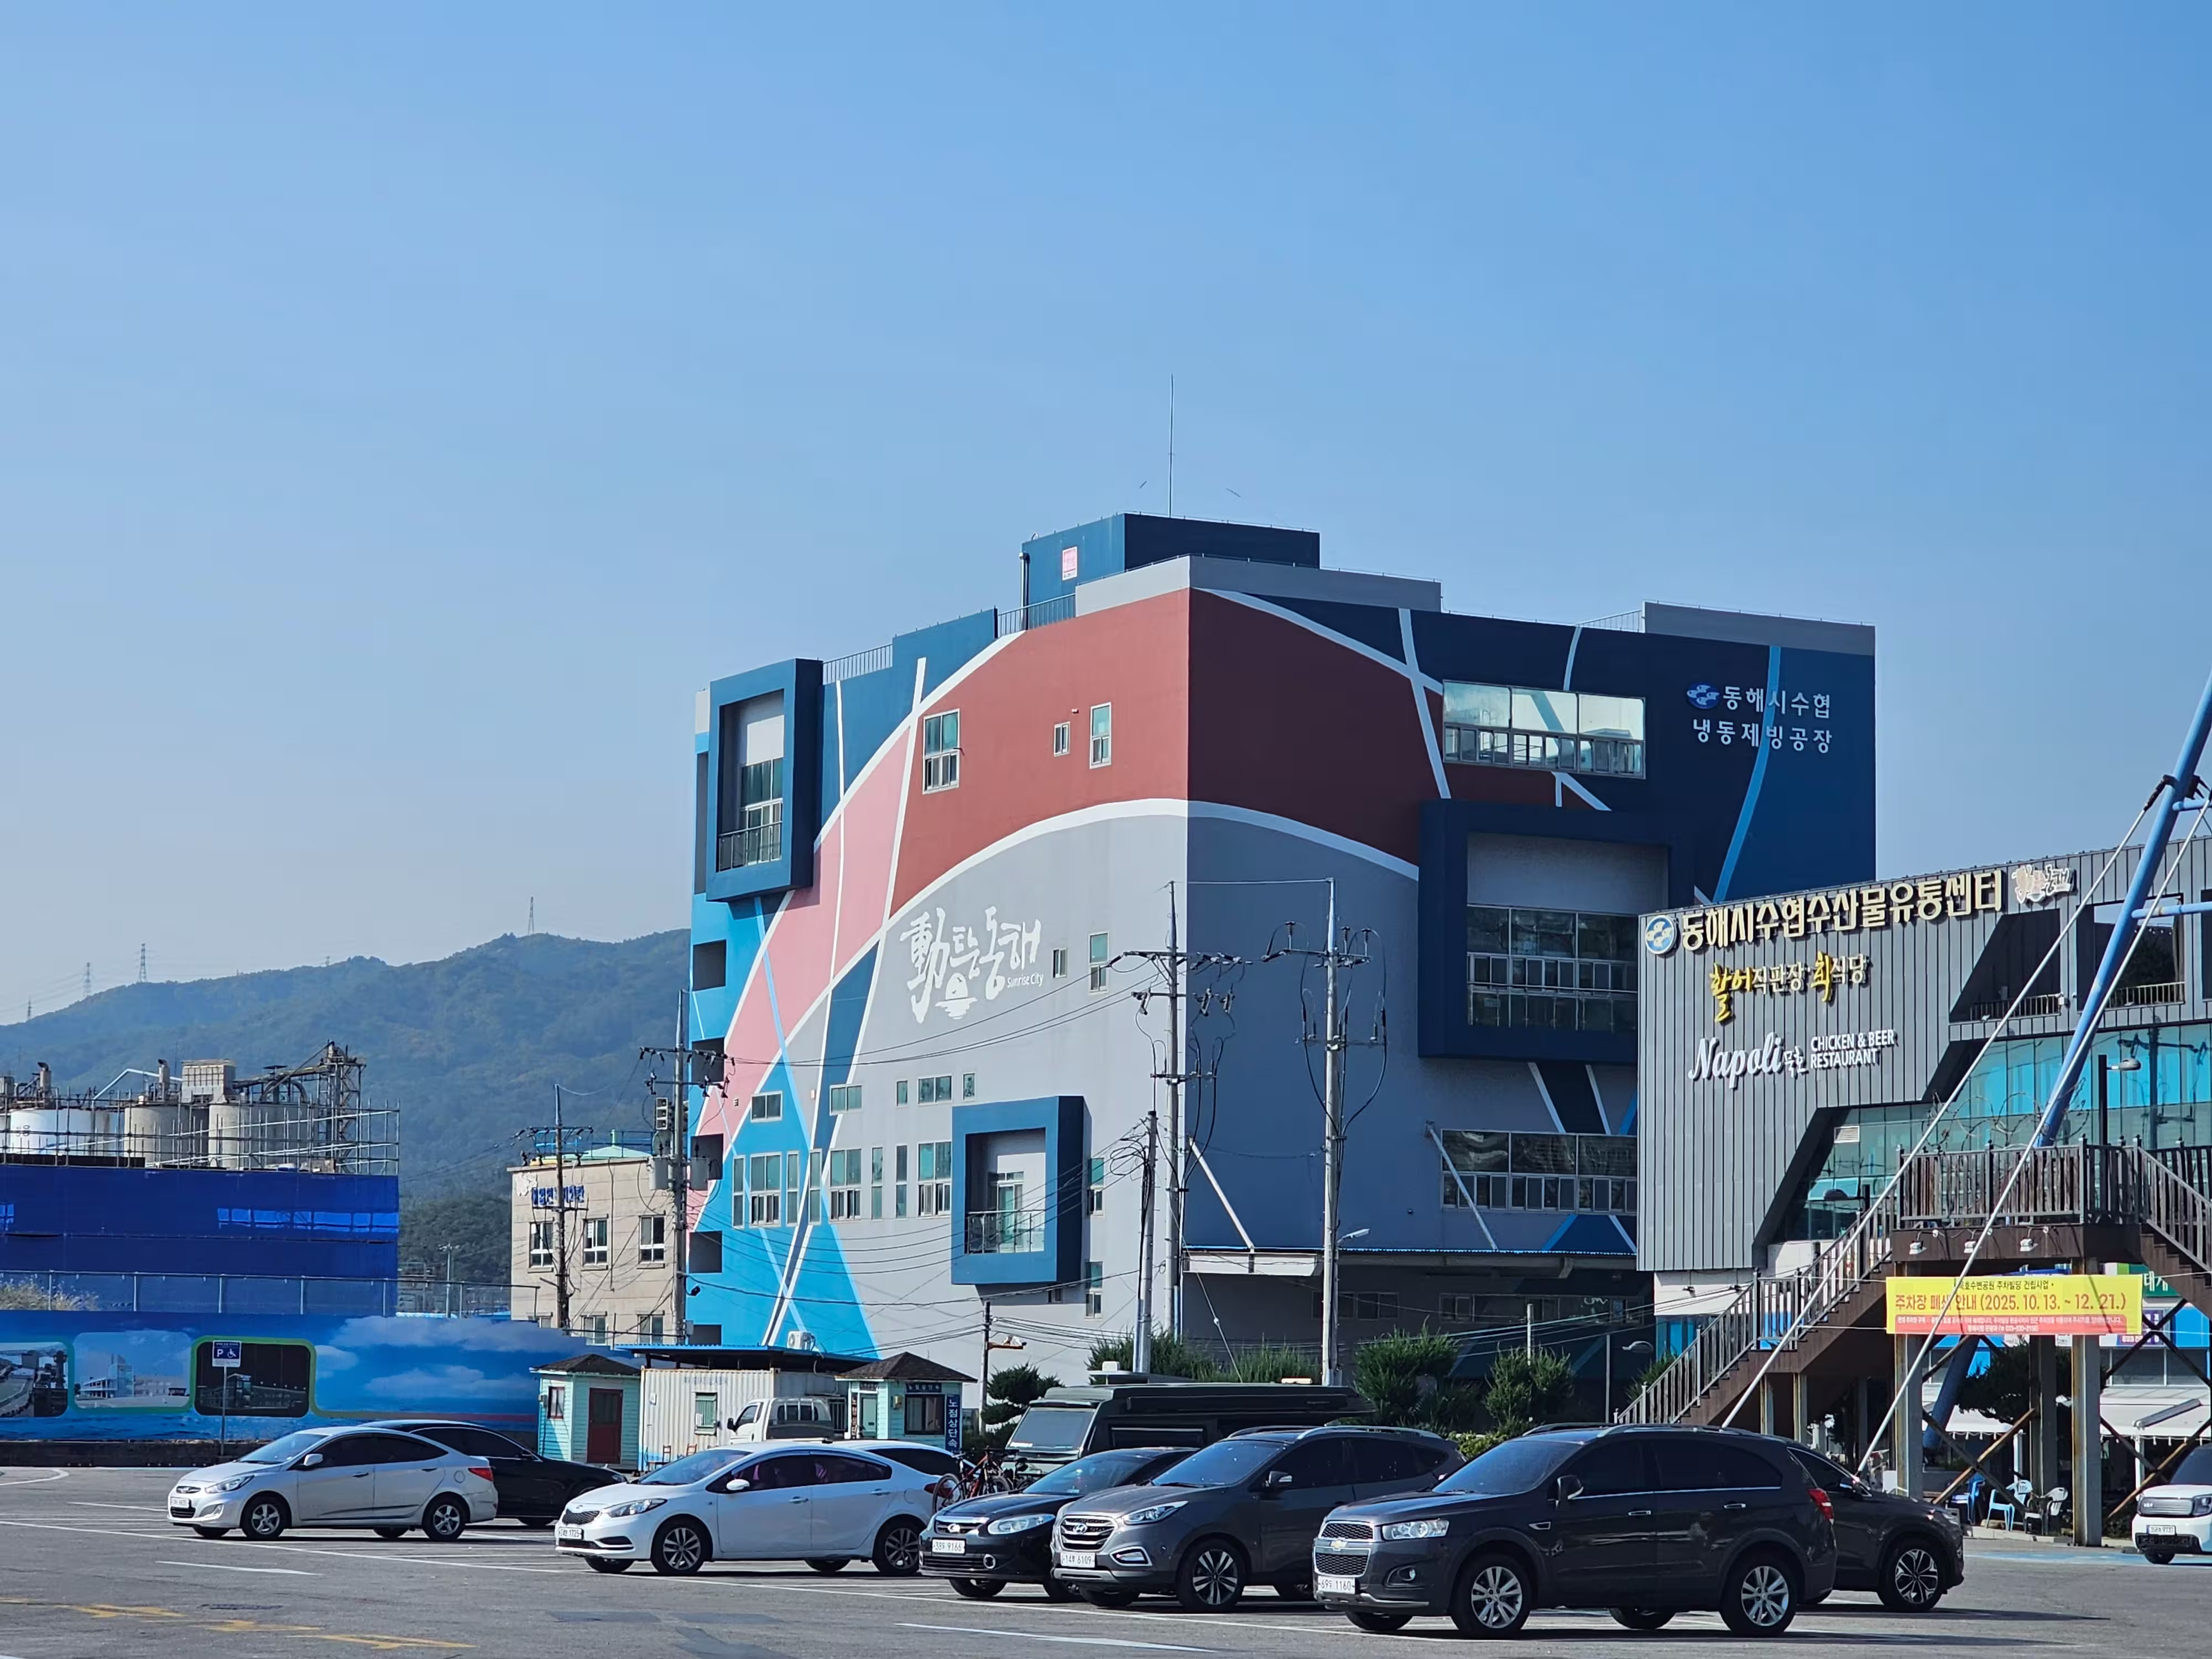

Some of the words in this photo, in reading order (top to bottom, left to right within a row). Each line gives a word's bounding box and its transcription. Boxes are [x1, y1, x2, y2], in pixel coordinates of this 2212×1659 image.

[1723, 686, 1830, 718] 동해시수협
[1693, 719, 1832, 753] 냉동제빙공장
[1007, 974, 1030, 988] Sunrise
[1030, 972, 1044, 987] City
[1811, 1033, 1854, 1052] CHICKEN
[1858, 1035, 1868, 1048] &
[1869, 1029, 1895, 1046] BEER
[1688, 1031, 1782, 1088] Napoli
[1810, 1048, 1879, 1069] RESTAURANT
[1997, 1281, 2021, 1290] 주차빌딩
[2024, 1280, 2049, 1290] 건립사업
[1896, 1294, 1927, 1311] 주차장
[1955, 1294, 1976, 1311] 안내
[1981, 1294, 2019, 1311] (2025.
[2023, 1294, 2039, 1310] 10.
[2044, 1294, 2060, 1310] 13.
[2075, 1293, 2094, 1310] 12.
[2099, 1292, 2126, 1310] 21.)
[217, 1349, 223, 1357] P
[947, 1542, 962, 1552] 9166
[1077, 1555, 1092, 1564] 6109
[1335, 1580, 1351, 1591] 1160
